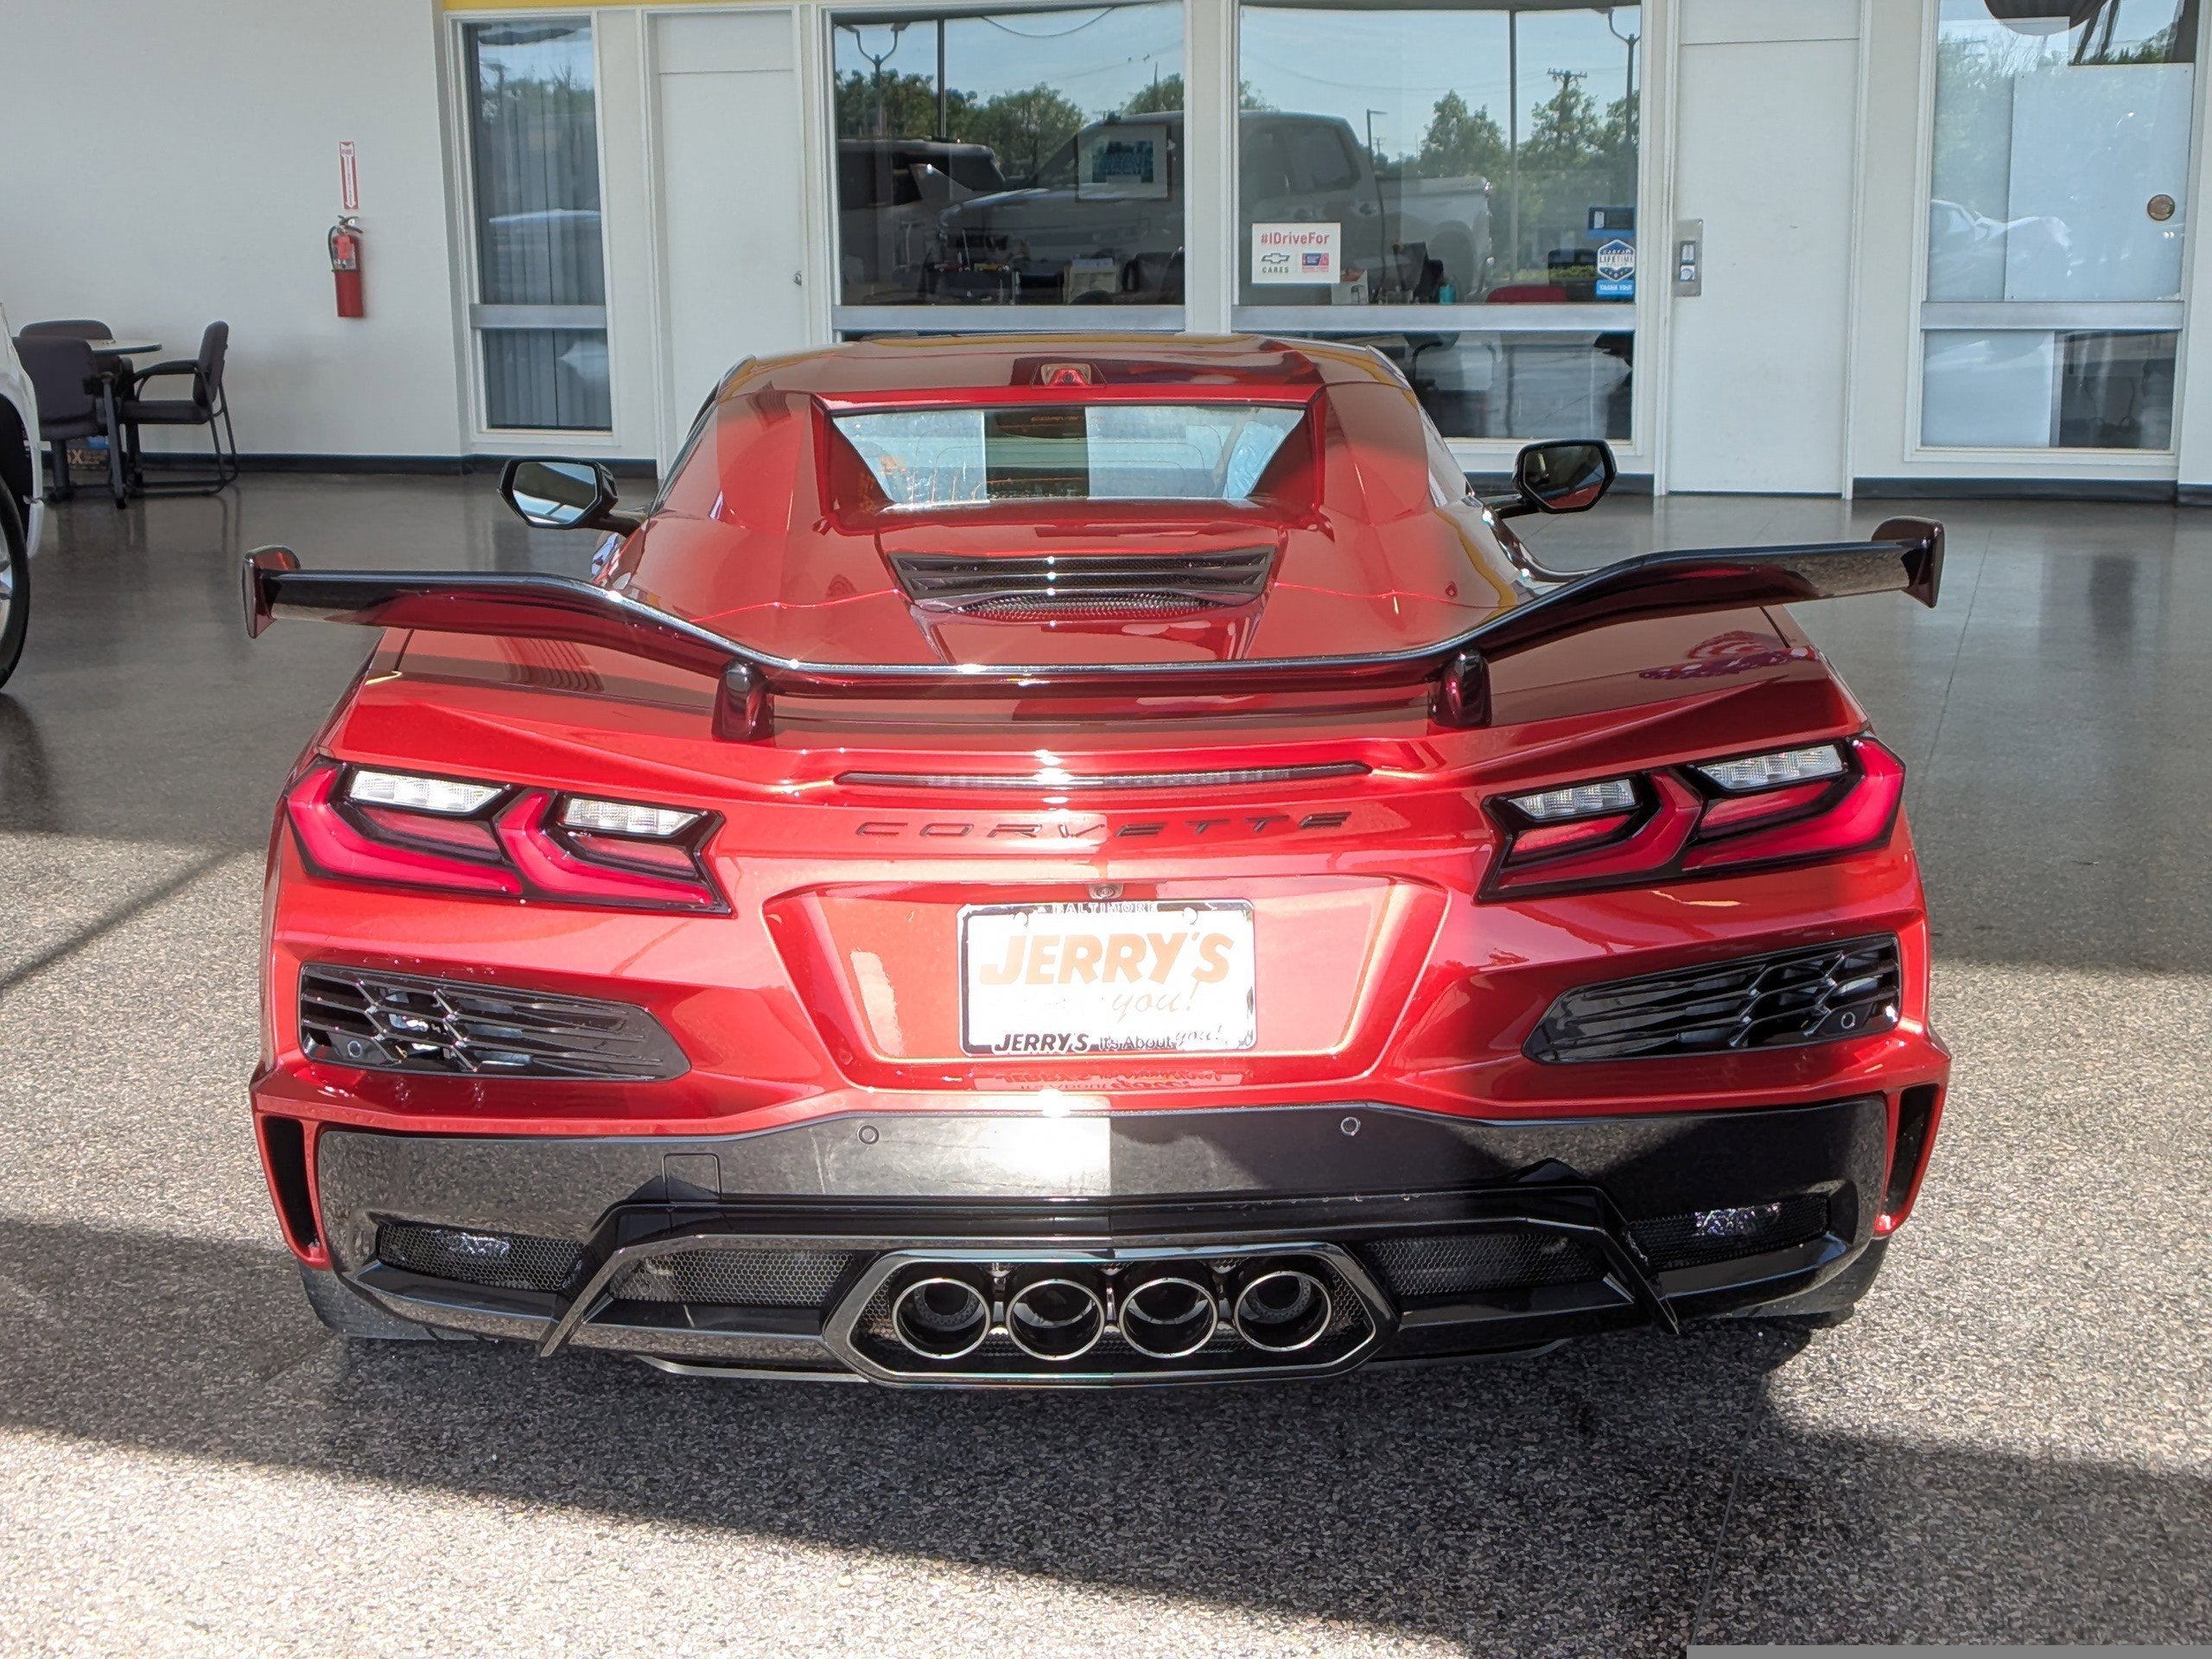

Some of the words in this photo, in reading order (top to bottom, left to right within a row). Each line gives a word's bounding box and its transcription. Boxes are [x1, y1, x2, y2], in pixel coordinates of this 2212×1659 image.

[1260, 231, 1331, 245] #IDriveFor
[855, 810, 1353, 838] CORVETTE
[1052, 901, 1157, 914] BALTIMORE
[979, 931, 1235, 985] JERRY'S
[1111, 979, 1201, 1023] you!
[994, 1033, 1090, 1052] JERRY'S
